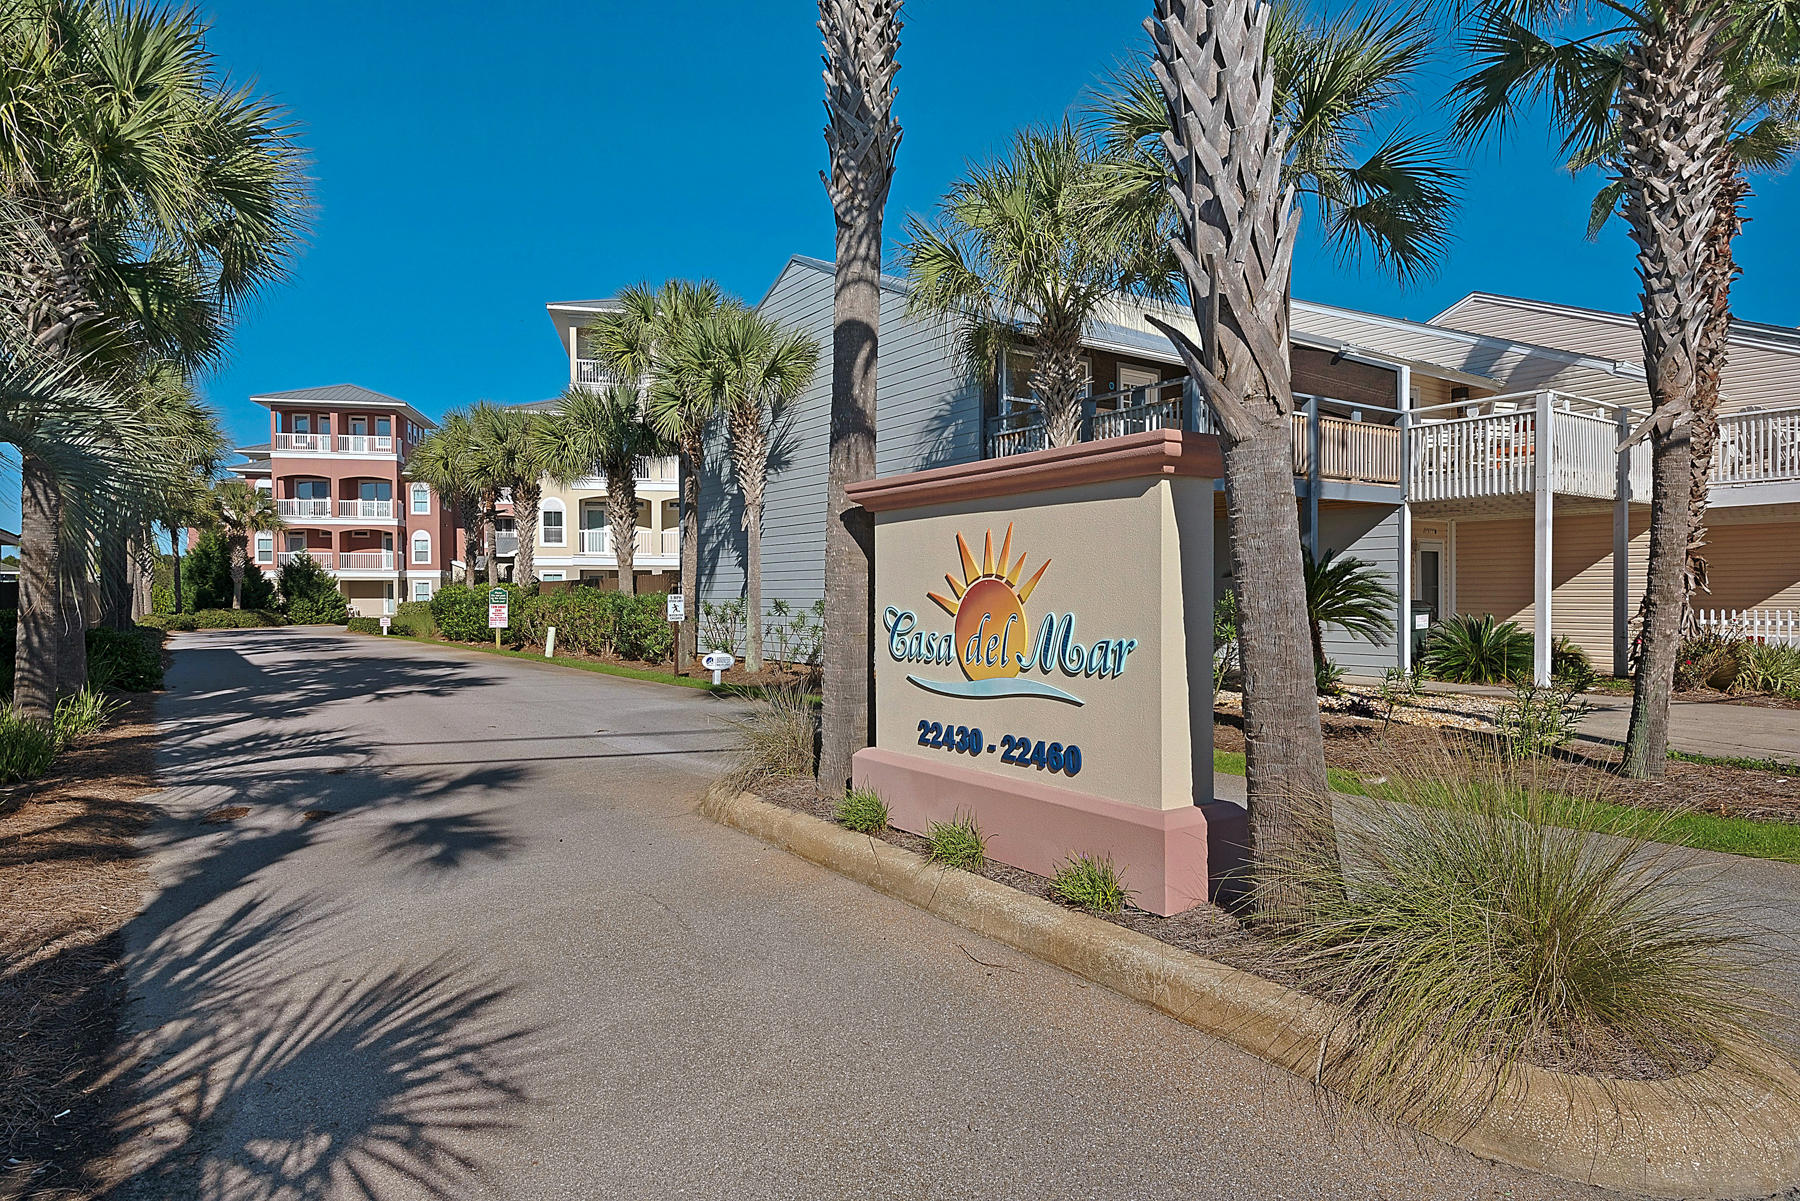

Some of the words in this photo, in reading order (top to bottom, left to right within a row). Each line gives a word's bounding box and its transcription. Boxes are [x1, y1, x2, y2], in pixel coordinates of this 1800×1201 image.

[883, 605, 956, 664] Casa
[964, 612, 1018, 669] del
[1016, 611, 1138, 678] Mar
[917, 719, 983, 757] 22430
[1000, 734, 1083, 777] 22460
